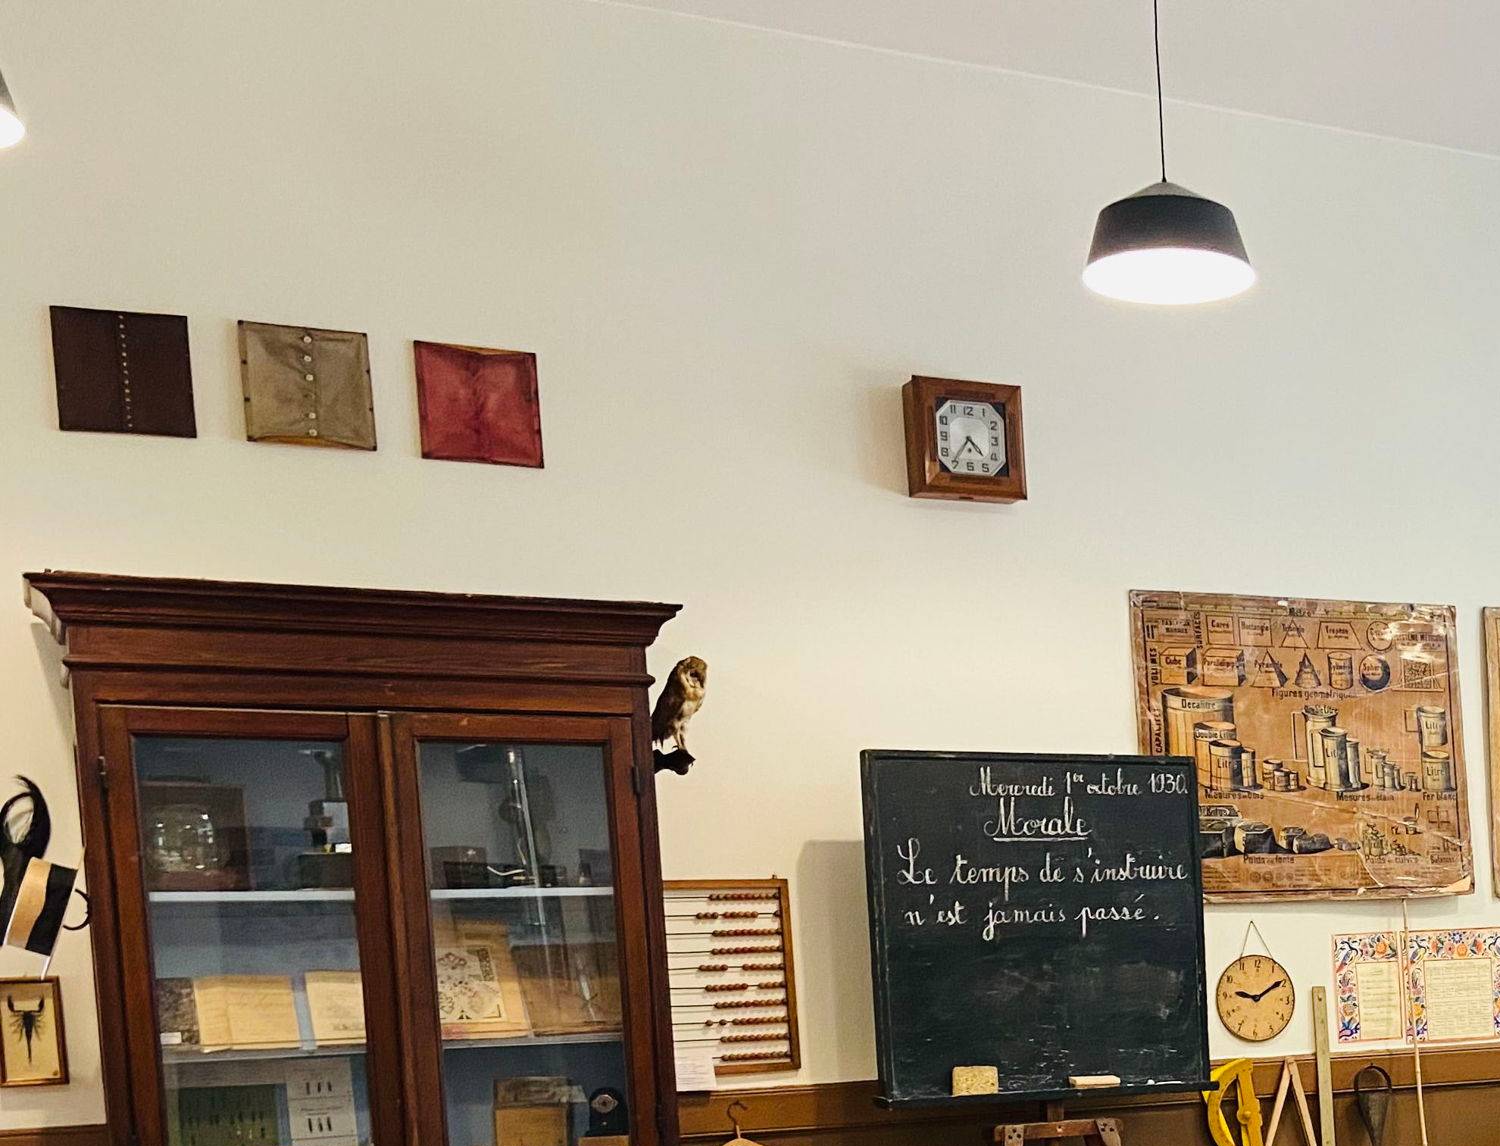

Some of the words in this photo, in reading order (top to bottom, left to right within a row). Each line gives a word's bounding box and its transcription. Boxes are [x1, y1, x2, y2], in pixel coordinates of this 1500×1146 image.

[969, 766, 1055, 796] Mercredi
[1086, 768, 1142, 796] octobre
[984, 796, 1092, 837] Morale
[897, 837, 937, 885] Le
[949, 854, 1029, 901] temps
[1039, 852, 1066, 883] de
[1072, 848, 1188, 884] s'instruire
[904, 894, 967, 926] n'est
[983, 901, 1066, 941] jamais
